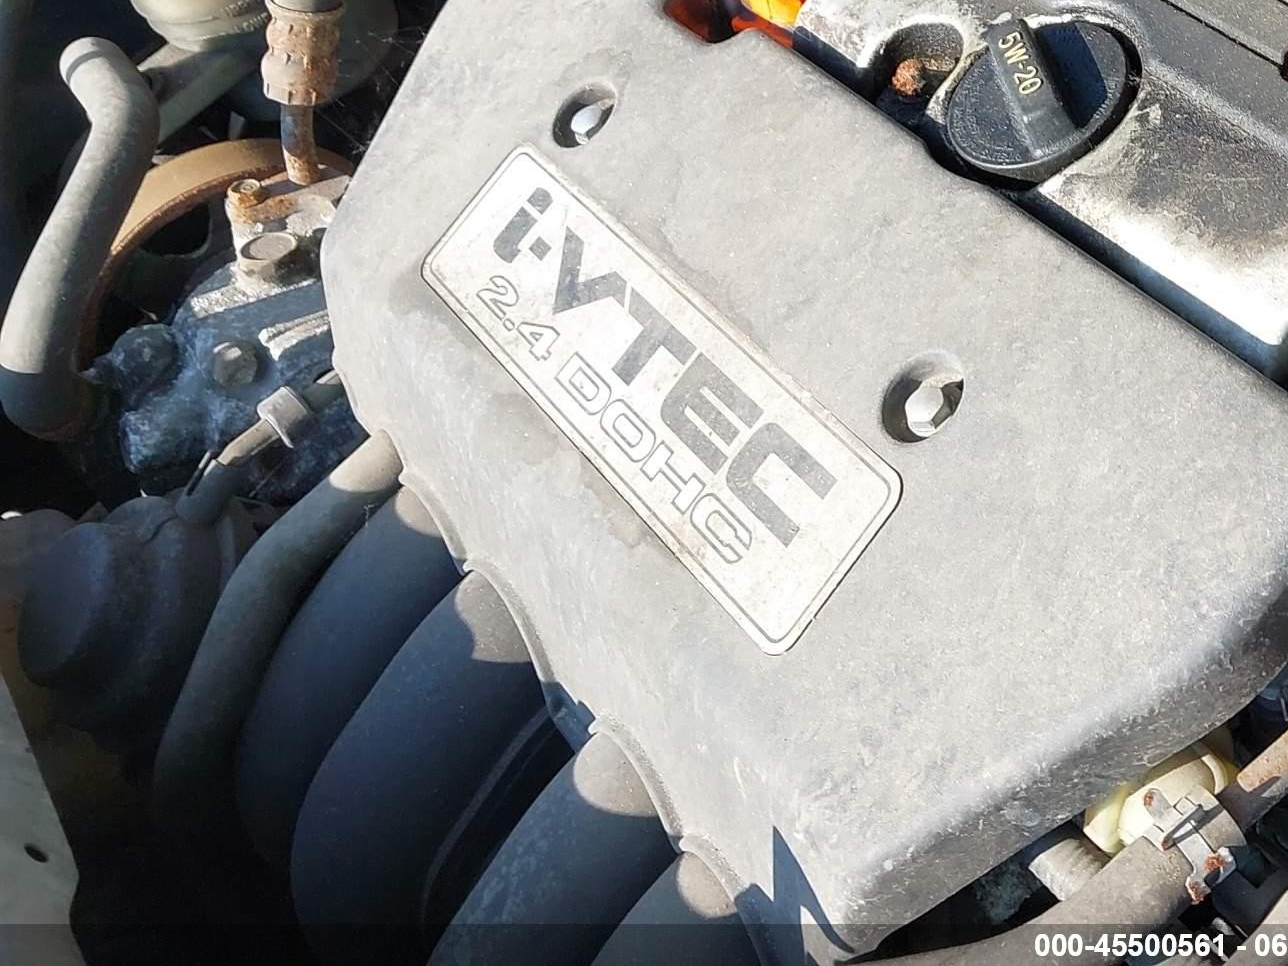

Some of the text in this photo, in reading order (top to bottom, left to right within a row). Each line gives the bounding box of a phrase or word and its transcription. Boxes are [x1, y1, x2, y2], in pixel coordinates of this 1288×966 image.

[232, 12, 270, 33] LOWE
[998, 31, 1044, 95] 5W-20
[476, 275, 753, 564] 2.4 DOHC
